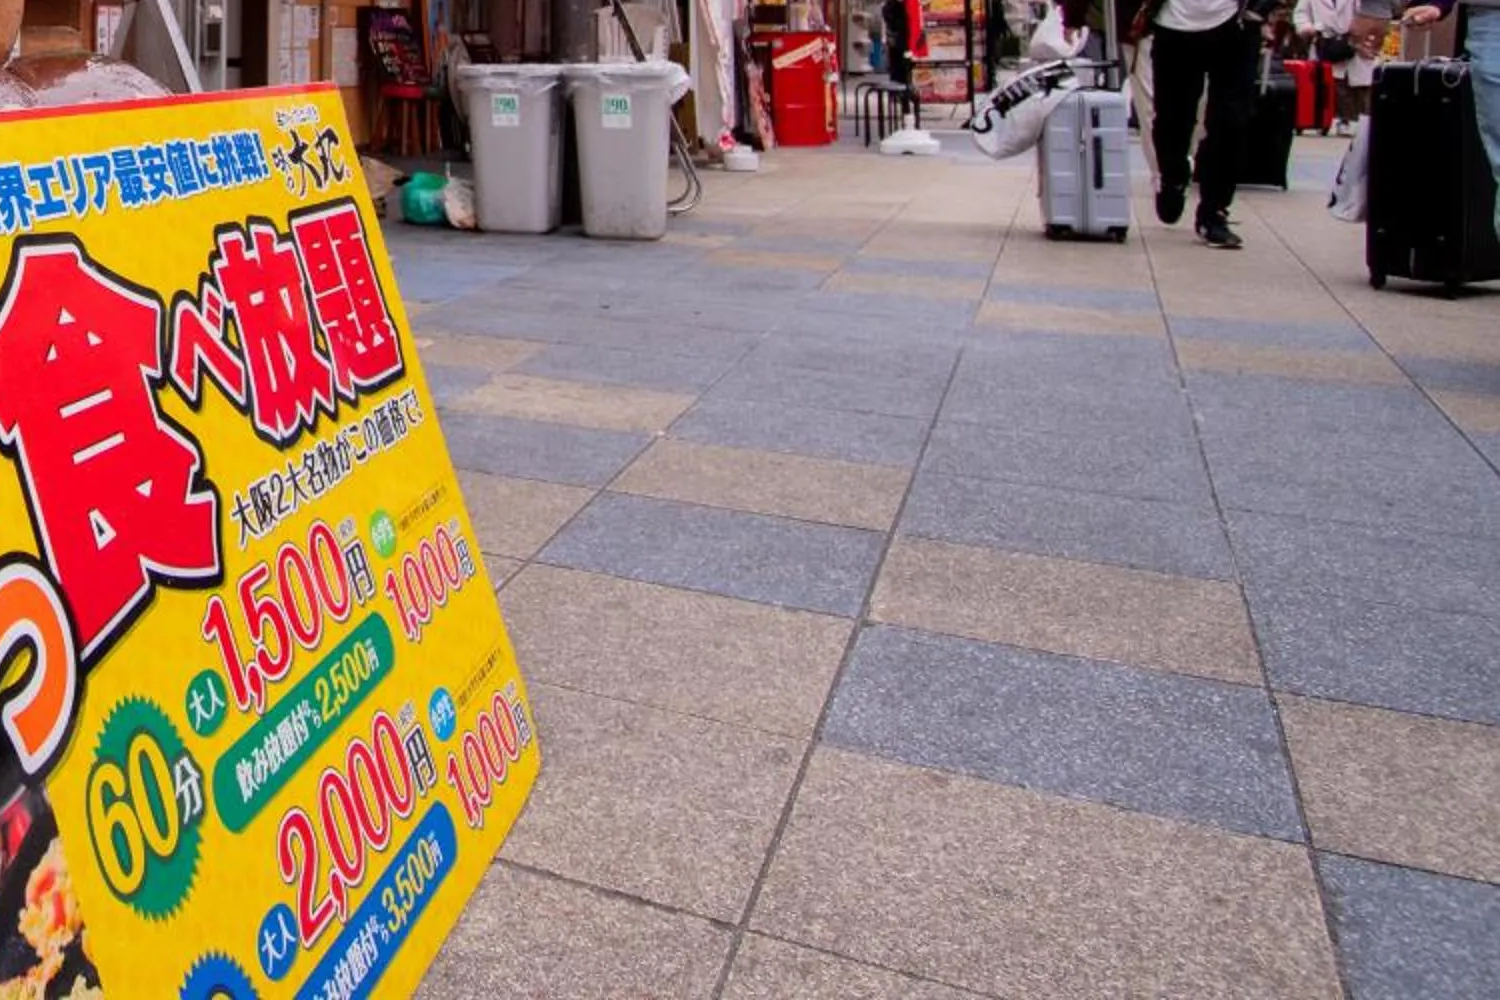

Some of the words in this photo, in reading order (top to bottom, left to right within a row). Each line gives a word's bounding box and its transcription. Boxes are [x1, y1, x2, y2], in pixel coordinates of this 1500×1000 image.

[203, 520, 376, 714] 1,500円
[86, 732, 202, 897] 60分
[278, 711, 438, 950] 2,000円
